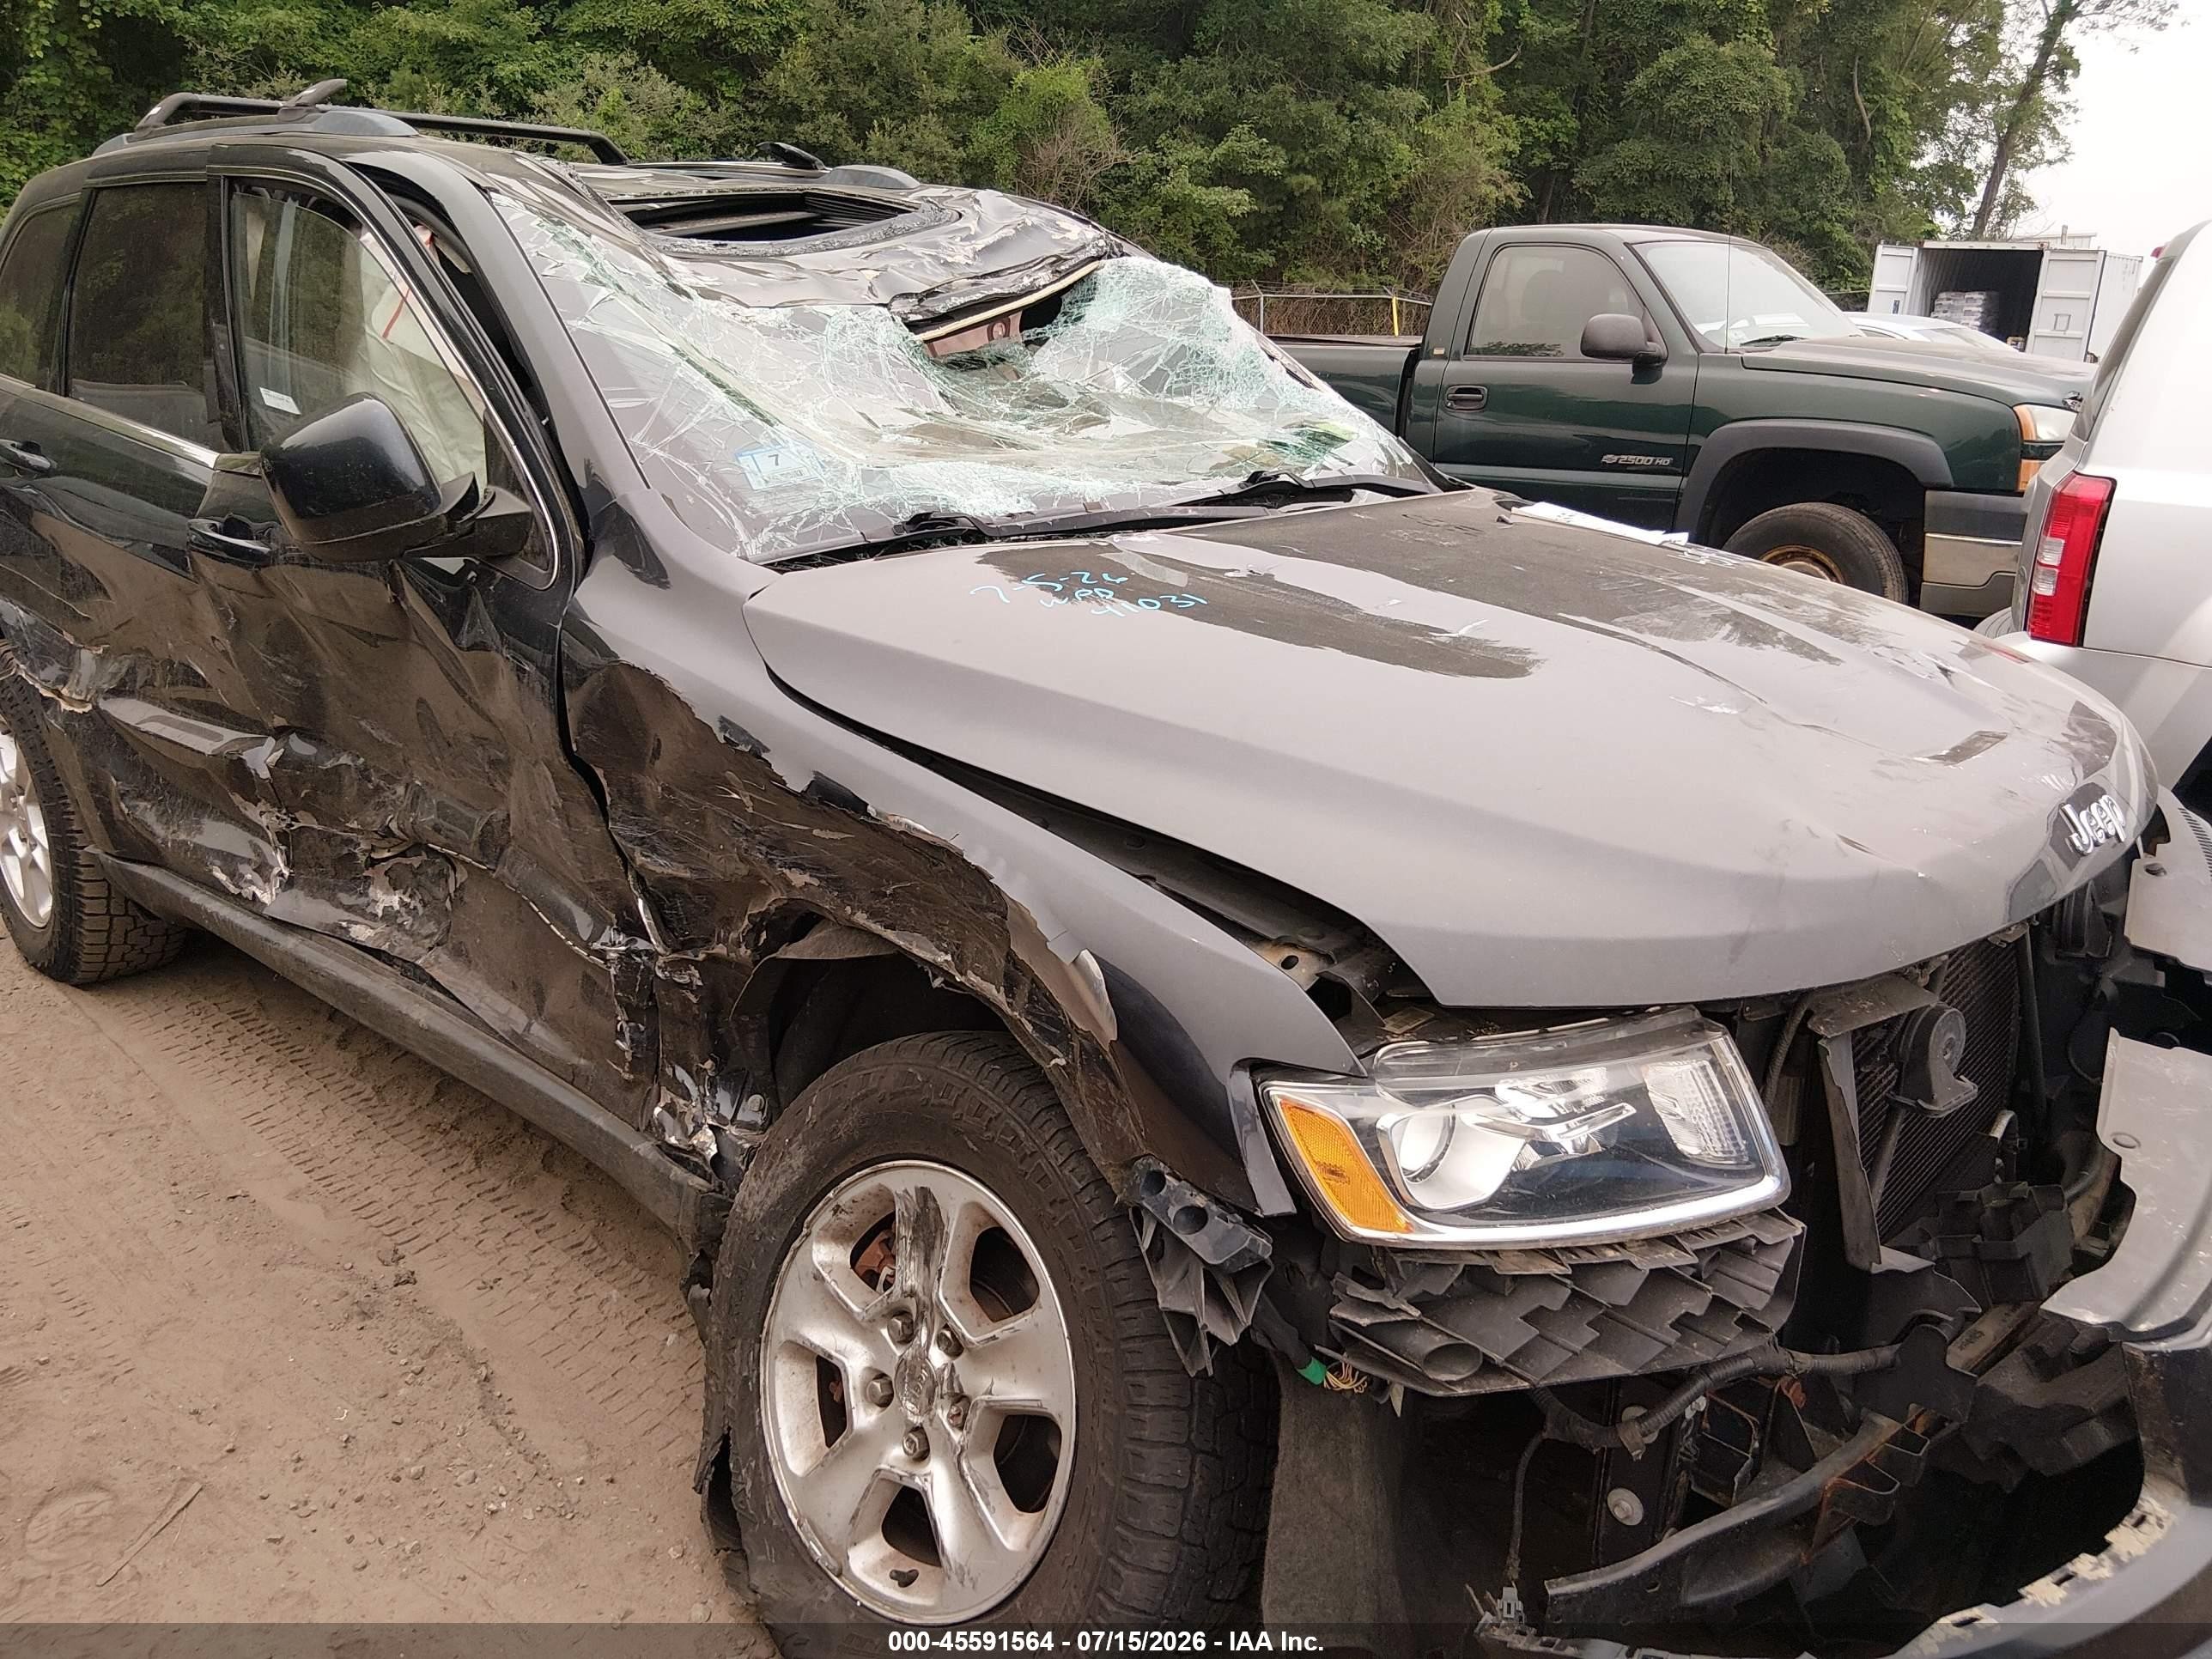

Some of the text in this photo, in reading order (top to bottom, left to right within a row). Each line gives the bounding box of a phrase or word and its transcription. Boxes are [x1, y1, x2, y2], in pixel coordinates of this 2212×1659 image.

[768, 453, 779, 466] 7
[1618, 454, 1674, 465] 2500 HD
[2059, 794, 2126, 855] Jeep
